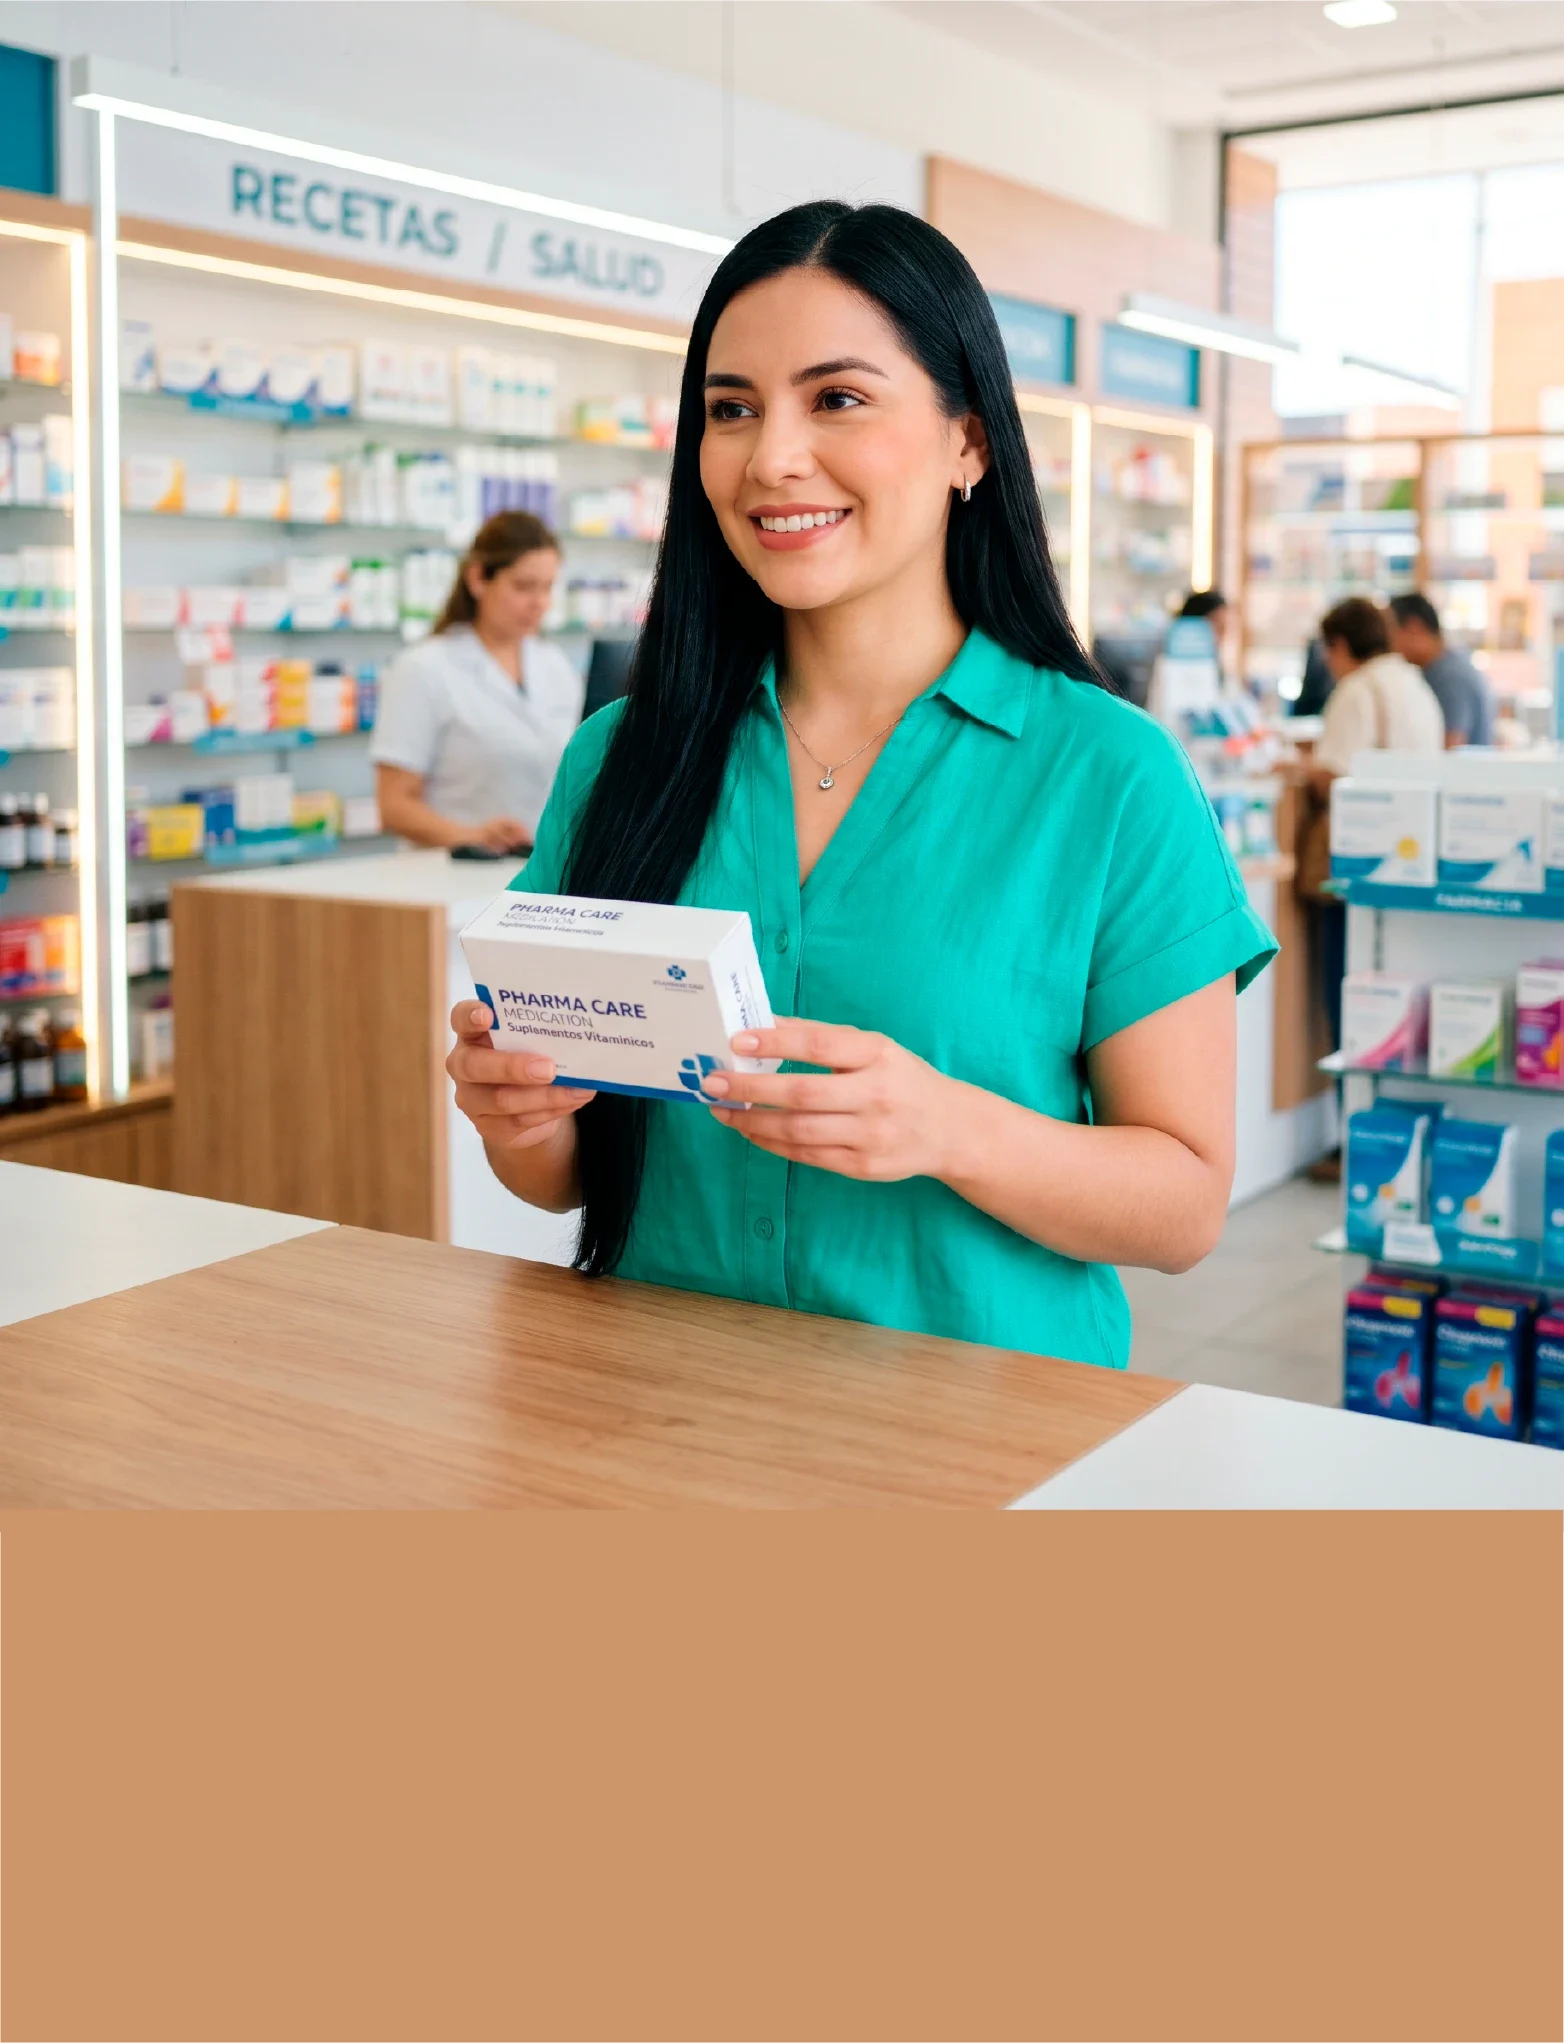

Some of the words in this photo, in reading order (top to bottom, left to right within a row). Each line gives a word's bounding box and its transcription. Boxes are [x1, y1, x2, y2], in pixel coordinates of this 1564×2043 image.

[230, 163, 459, 257] RECETAS
[530, 231, 666, 298] SALUD
[510, 903, 576, 917] PHARMA
[579, 909, 624, 921] CARE
[498, 989, 588, 1013] PHARMA
[591, 999, 648, 1020] CARE
[503, 1007, 595, 1029] MEDICATION
[507, 1022, 584, 1041] Suplementos
[584, 1030, 656, 1049] Vitaminicos
